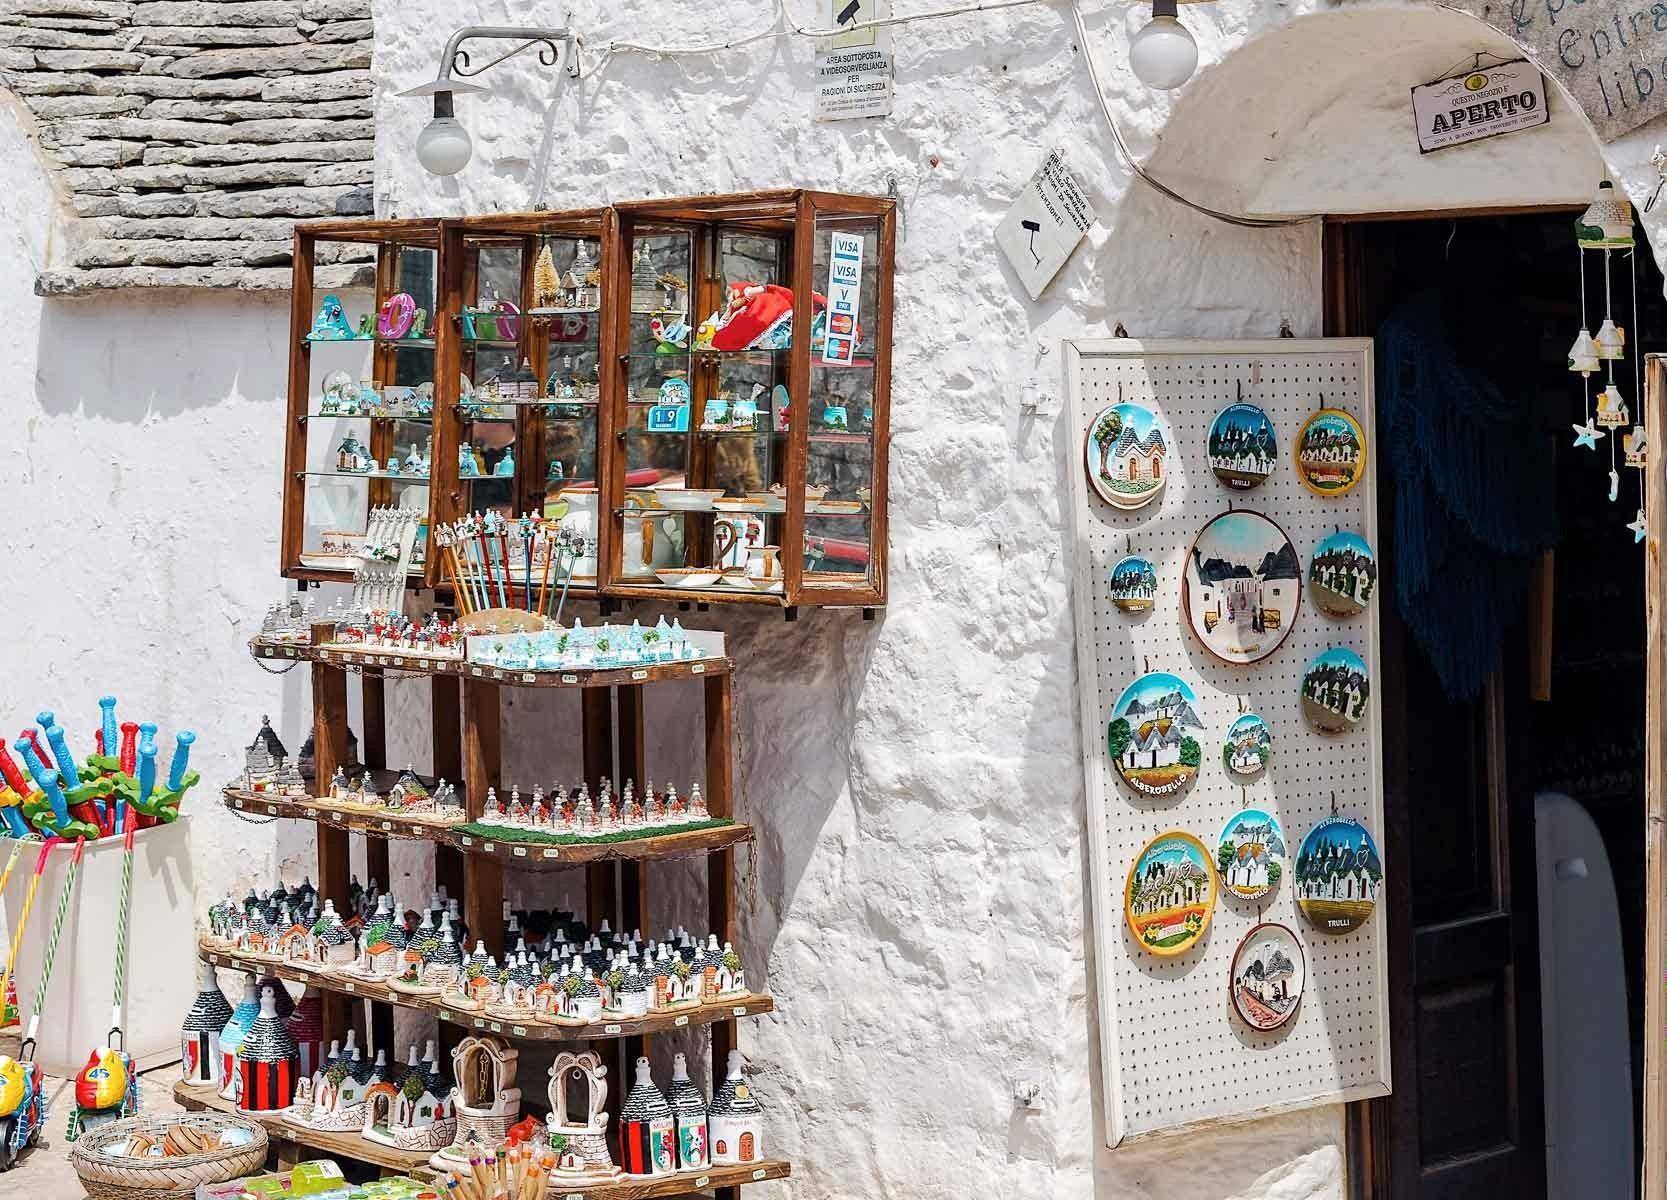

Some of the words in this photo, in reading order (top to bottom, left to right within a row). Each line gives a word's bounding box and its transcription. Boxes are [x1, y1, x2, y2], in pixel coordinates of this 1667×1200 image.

[826, 55, 843, 65] AREA
[842, 51, 882, 63] SOTTOPOSTA
[820, 67, 825, 76] A
[826, 60, 888, 75] VIDEOSORVEGLIANZA
[847, 75, 860, 83] PER
[1597, 55, 1667, 117] lib
[821, 86, 846, 97] RAGIONI
[847, 85, 853, 94] DI
[853, 82, 886, 94] SICUREZZA
[1451, 94, 1476, 106] QUESTO
[1476, 87, 1504, 101] NEGOZIO
[1431, 90, 1537, 135] APERTO
[1049, 154, 1064, 174] AREA
[838, 239, 858, 253] VISA
[836, 264, 857, 279] VISA
[840, 288, 849, 301] V
[1130, 773, 1188, 795] ALBEROBELLO
[1328, 919, 1350, 928] TRULLI
[88, 1067, 111, 1080] 45
